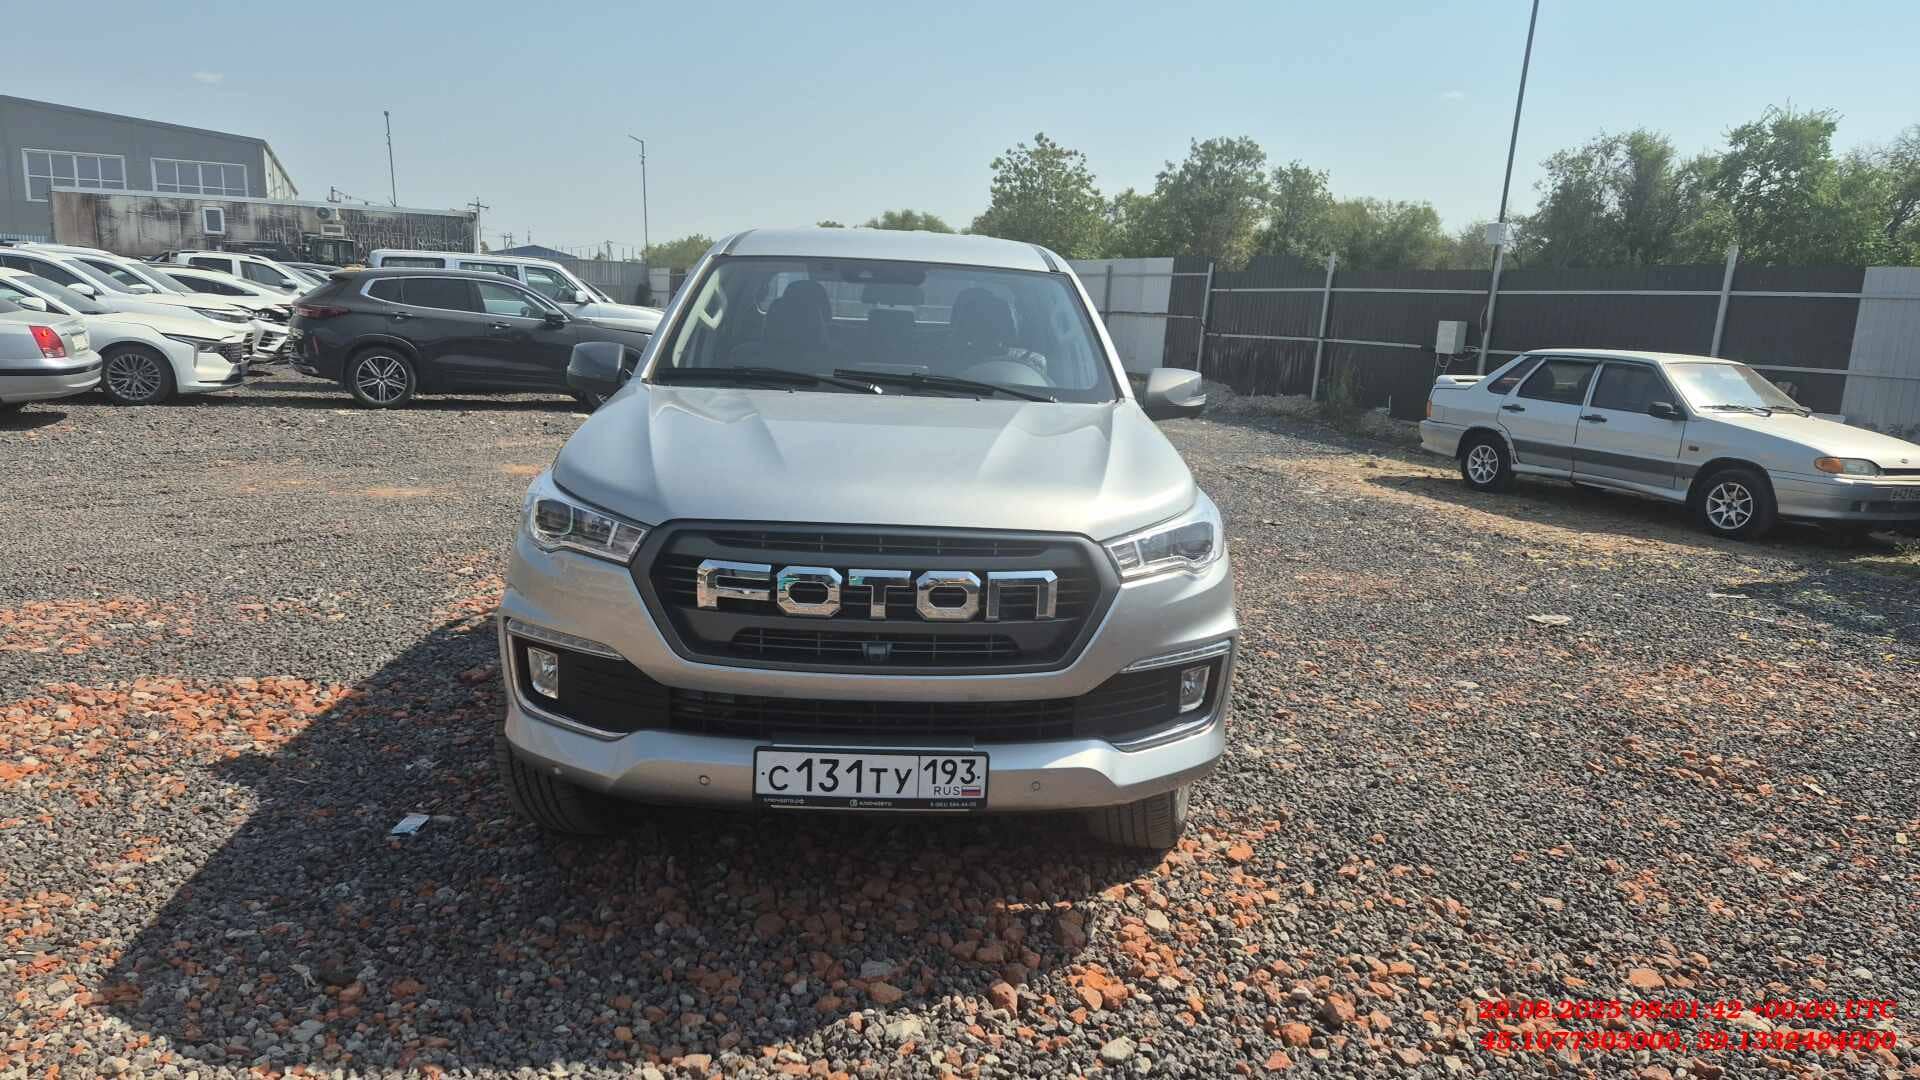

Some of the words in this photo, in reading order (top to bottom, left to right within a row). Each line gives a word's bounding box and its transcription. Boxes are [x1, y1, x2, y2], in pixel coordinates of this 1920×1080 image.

[697, 559, 1058, 621] FOTON
[923, 759, 976, 785] 193
[934, 786, 960, 796] RUS
